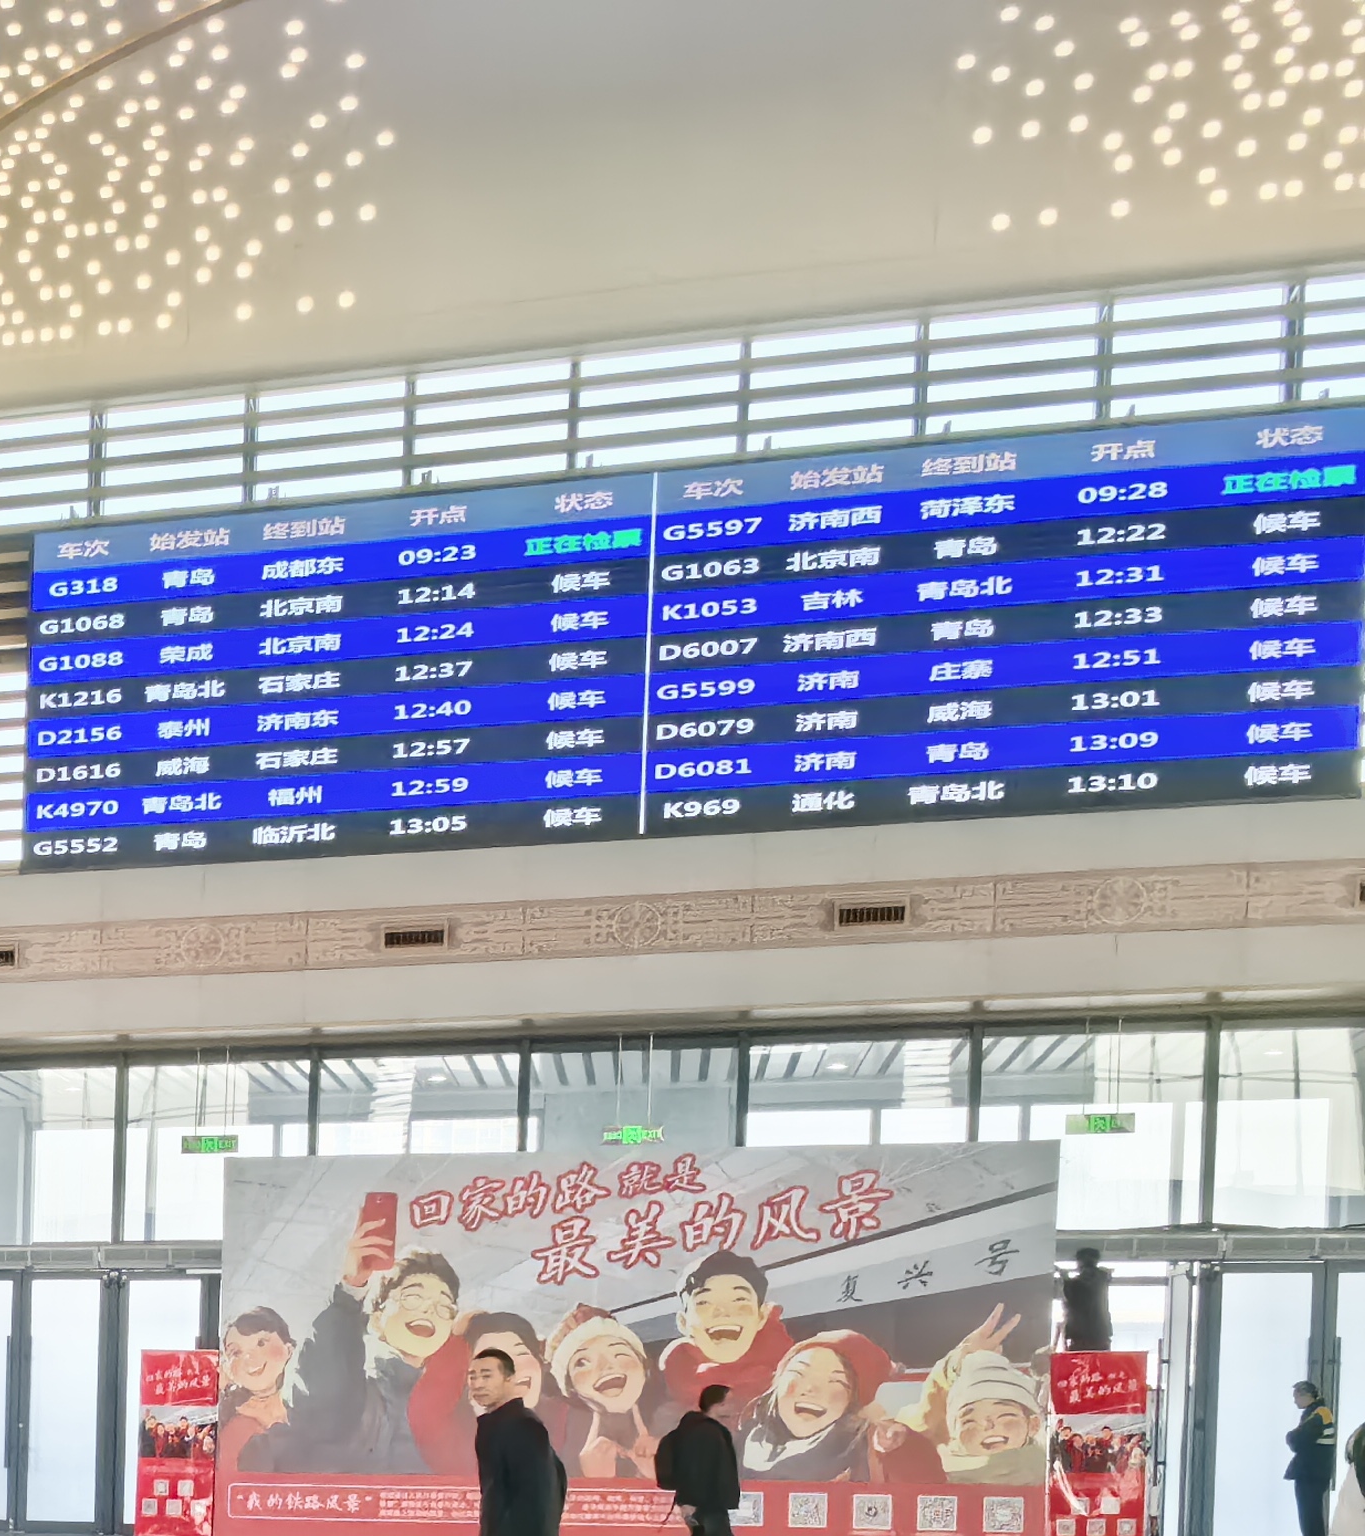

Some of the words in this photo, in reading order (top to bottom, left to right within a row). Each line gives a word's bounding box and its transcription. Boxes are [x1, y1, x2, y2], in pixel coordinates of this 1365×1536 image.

[683, 478, 743, 500] 车次
[790, 463, 884, 490] 始发站
[921, 451, 1017, 477] 终到站
[1091, 440, 1156, 462] 开点
[1256, 424, 1323, 448] 状态
[57, 539, 110, 559] 车次
[149, 527, 230, 552] 始发站
[263, 516, 346, 540] 终到站
[410, 505, 467, 527] 开点
[554, 490, 613, 513] 状态
[664, 517, 762, 540] G5597
[789, 506, 882, 531] 济南西
[921, 494, 1014, 519] 菏泽东
[1078, 482, 1167, 503] 09:28
[50, 578, 117, 596] G318
[162, 569, 214, 588] 青岛
[262, 557, 343, 579] 成都东
[399, 545, 476, 565] 09:23
[662, 558, 759, 580] G1063
[786, 547, 880, 572] 北京南
[934, 536, 997, 559] 青岛
[1077, 524, 1165, 545] 12:22
[1253, 511, 1321, 534] 候车
[40, 613, 124, 634] G1068
[161, 606, 213, 626] 青岛
[260, 595, 343, 617] 北京南
[398, 583, 475, 604] 12:14
[551, 572, 610, 593] 候车
[663, 599, 757, 620] K1053
[801, 589, 863, 610] 吉林
[917, 576, 1012, 601] 青岛北
[1077, 566, 1164, 586] 12:31
[1252, 554, 1318, 576] 候车
[39, 652, 123, 671] G1088
[160, 644, 213, 663] 荣成
[259, 634, 341, 655] 北京南
[397, 622, 474, 642] 12:24
[551, 611, 608, 632] 候车
[659, 638, 757, 660] D6007
[783, 627, 877, 652] 济南西
[931, 619, 994, 641] 青岛
[1075, 607, 1162, 628] 12:33
[1250, 595, 1318, 618] 候车
[40, 689, 122, 709] K1216
[144, 680, 225, 702] 青岛北
[258, 671, 340, 694] 石家庄
[395, 661, 472, 681] 12:37
[549, 650, 607, 671] 候车
[657, 679, 755, 699] G5599
[798, 671, 859, 691] 济南
[1074, 649, 1160, 669] 12:51
[1249, 638, 1315, 660] 候车
[38, 726, 121, 745] D2156
[158, 718, 209, 739] 泰州
[257, 710, 338, 731] 济南东
[395, 700, 471, 719] 12:40
[548, 690, 605, 710] 候车
[656, 718, 754, 740] D6079
[796, 711, 858, 732] 济南
[927, 701, 992, 723] 威海
[1072, 690, 1160, 710] 13:01
[1248, 680, 1314, 702] 候车
[36, 763, 121, 783] D1616
[156, 756, 209, 777] 威海
[256, 747, 338, 770] 石家庄
[393, 738, 470, 758] 12:57
[546, 729, 604, 750] 候车
[655, 759, 751, 779] D6081
[795, 751, 857, 771] 济南
[926, 742, 989, 763] 青岛
[1070, 732, 1158, 751] 13:09
[1247, 722, 1312, 744] 候车
[37, 801, 118, 818] K4970
[142, 793, 221, 814] 青岛北
[268, 786, 322, 806] 福州
[392, 778, 468, 796] 12:59
[545, 769, 602, 788] 候车
[664, 799, 740, 818] K969
[792, 790, 855, 812] 通化
[907, 781, 1004, 805] 青岛北
[1068, 773, 1158, 793] 13:10
[1244, 764, 1311, 786] 候车
[33, 837, 118, 855] G5552
[154, 830, 207, 851] 青岛
[252, 823, 336, 845] 临沂北
[390, 815, 467, 835] 13:05
[543, 807, 602, 827] 候车
[531, 1168, 895, 1287] 最美的风景
[835, 1239, 1020, 1302] 复兴号
